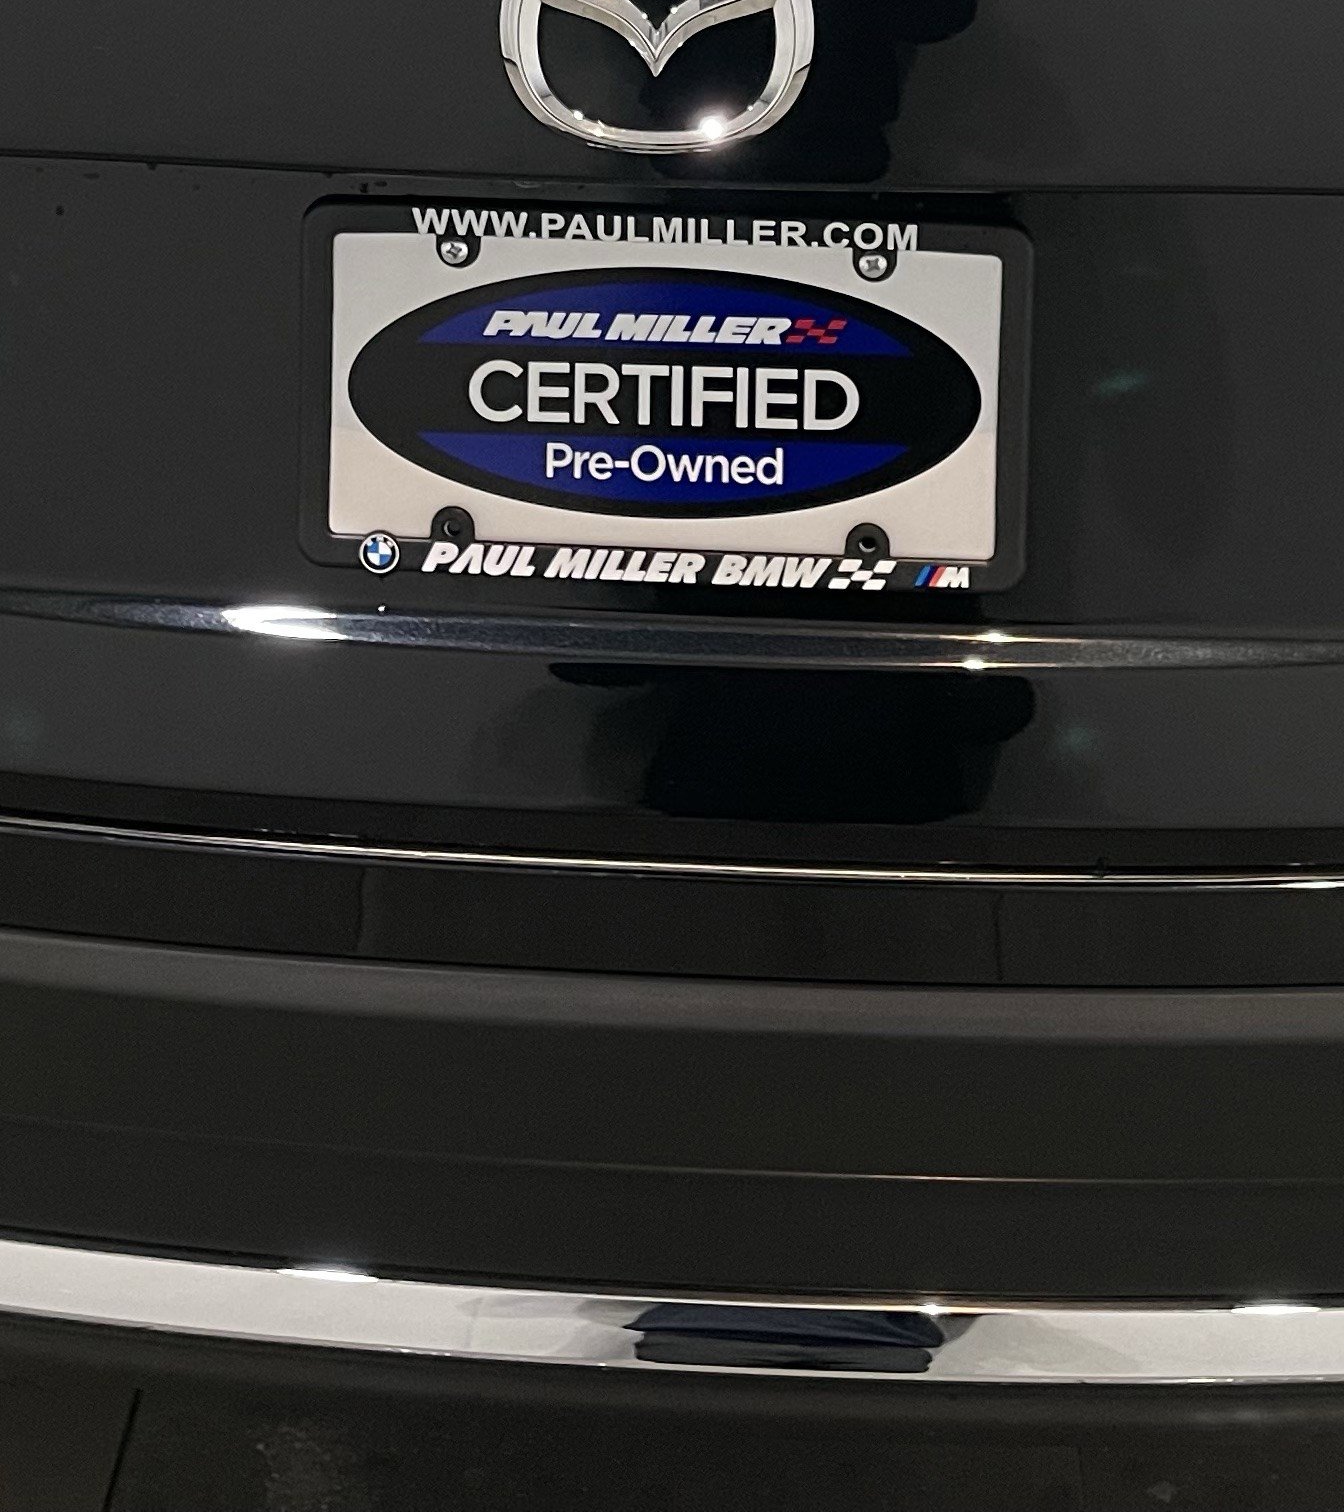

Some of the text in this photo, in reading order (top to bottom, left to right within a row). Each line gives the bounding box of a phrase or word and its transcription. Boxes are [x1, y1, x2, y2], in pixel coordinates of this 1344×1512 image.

[412, 207, 919, 251] WWW.PAULMILLER.COM
[483, 310, 792, 345] PAUL MILLER
[468, 359, 860, 430] CERTIFIED
[545, 442, 784, 485] Pre-Owned
[421, 541, 832, 588] PAUL MILLER BMW
